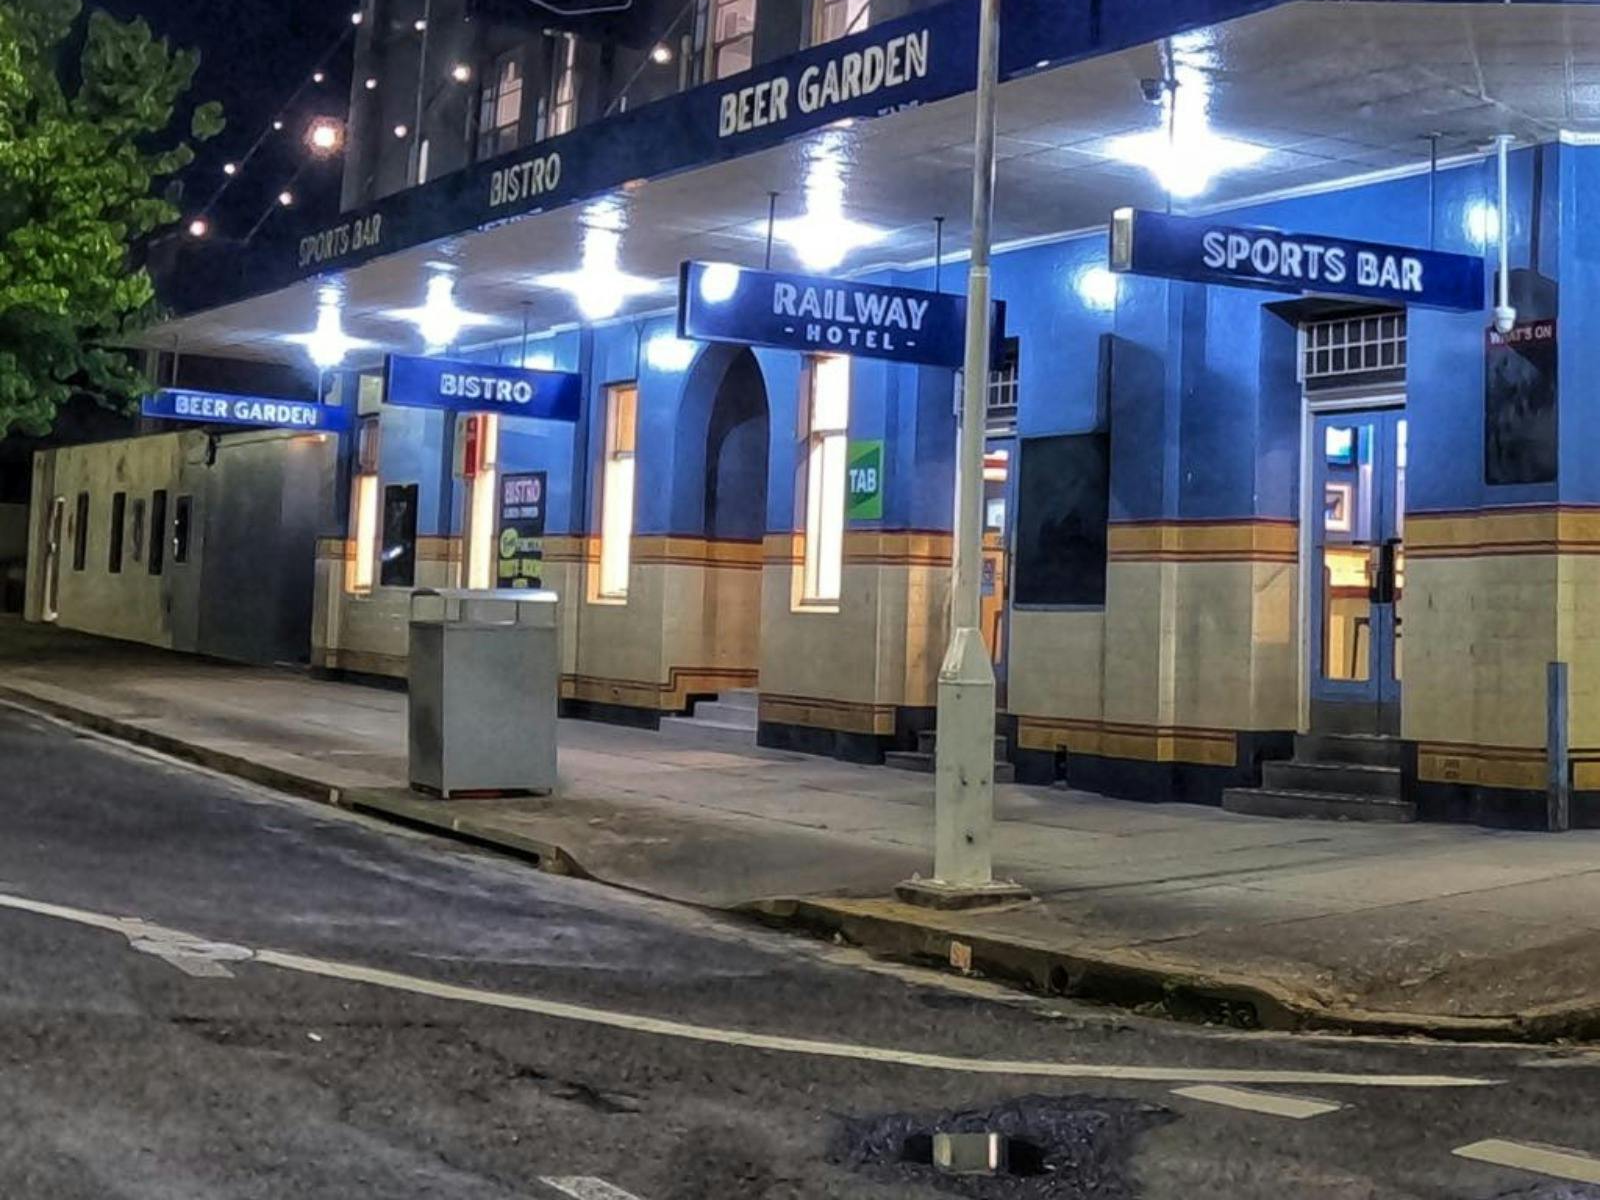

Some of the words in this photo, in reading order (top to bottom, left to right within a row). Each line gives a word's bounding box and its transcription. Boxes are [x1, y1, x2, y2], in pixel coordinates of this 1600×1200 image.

[718, 76, 790, 139] BEER
[797, 29, 930, 114] GARDEN
[489, 152, 562, 208] BISTRO
[298, 224, 351, 267] SPORTS
[352, 213, 382, 250] BAR
[1202, 231, 1347, 283] SPORTS
[1357, 251, 1424, 292] BAR
[773, 281, 929, 331] RAILWAY
[806, 323, 894, 351] HOTEL
[1534, 325, 1553, 339] ON
[439, 372, 533, 404] BISTRO
[174, 395, 229, 417] BEER
[234, 401, 318, 426] GARDEN
[849, 467, 878, 494] TAB
